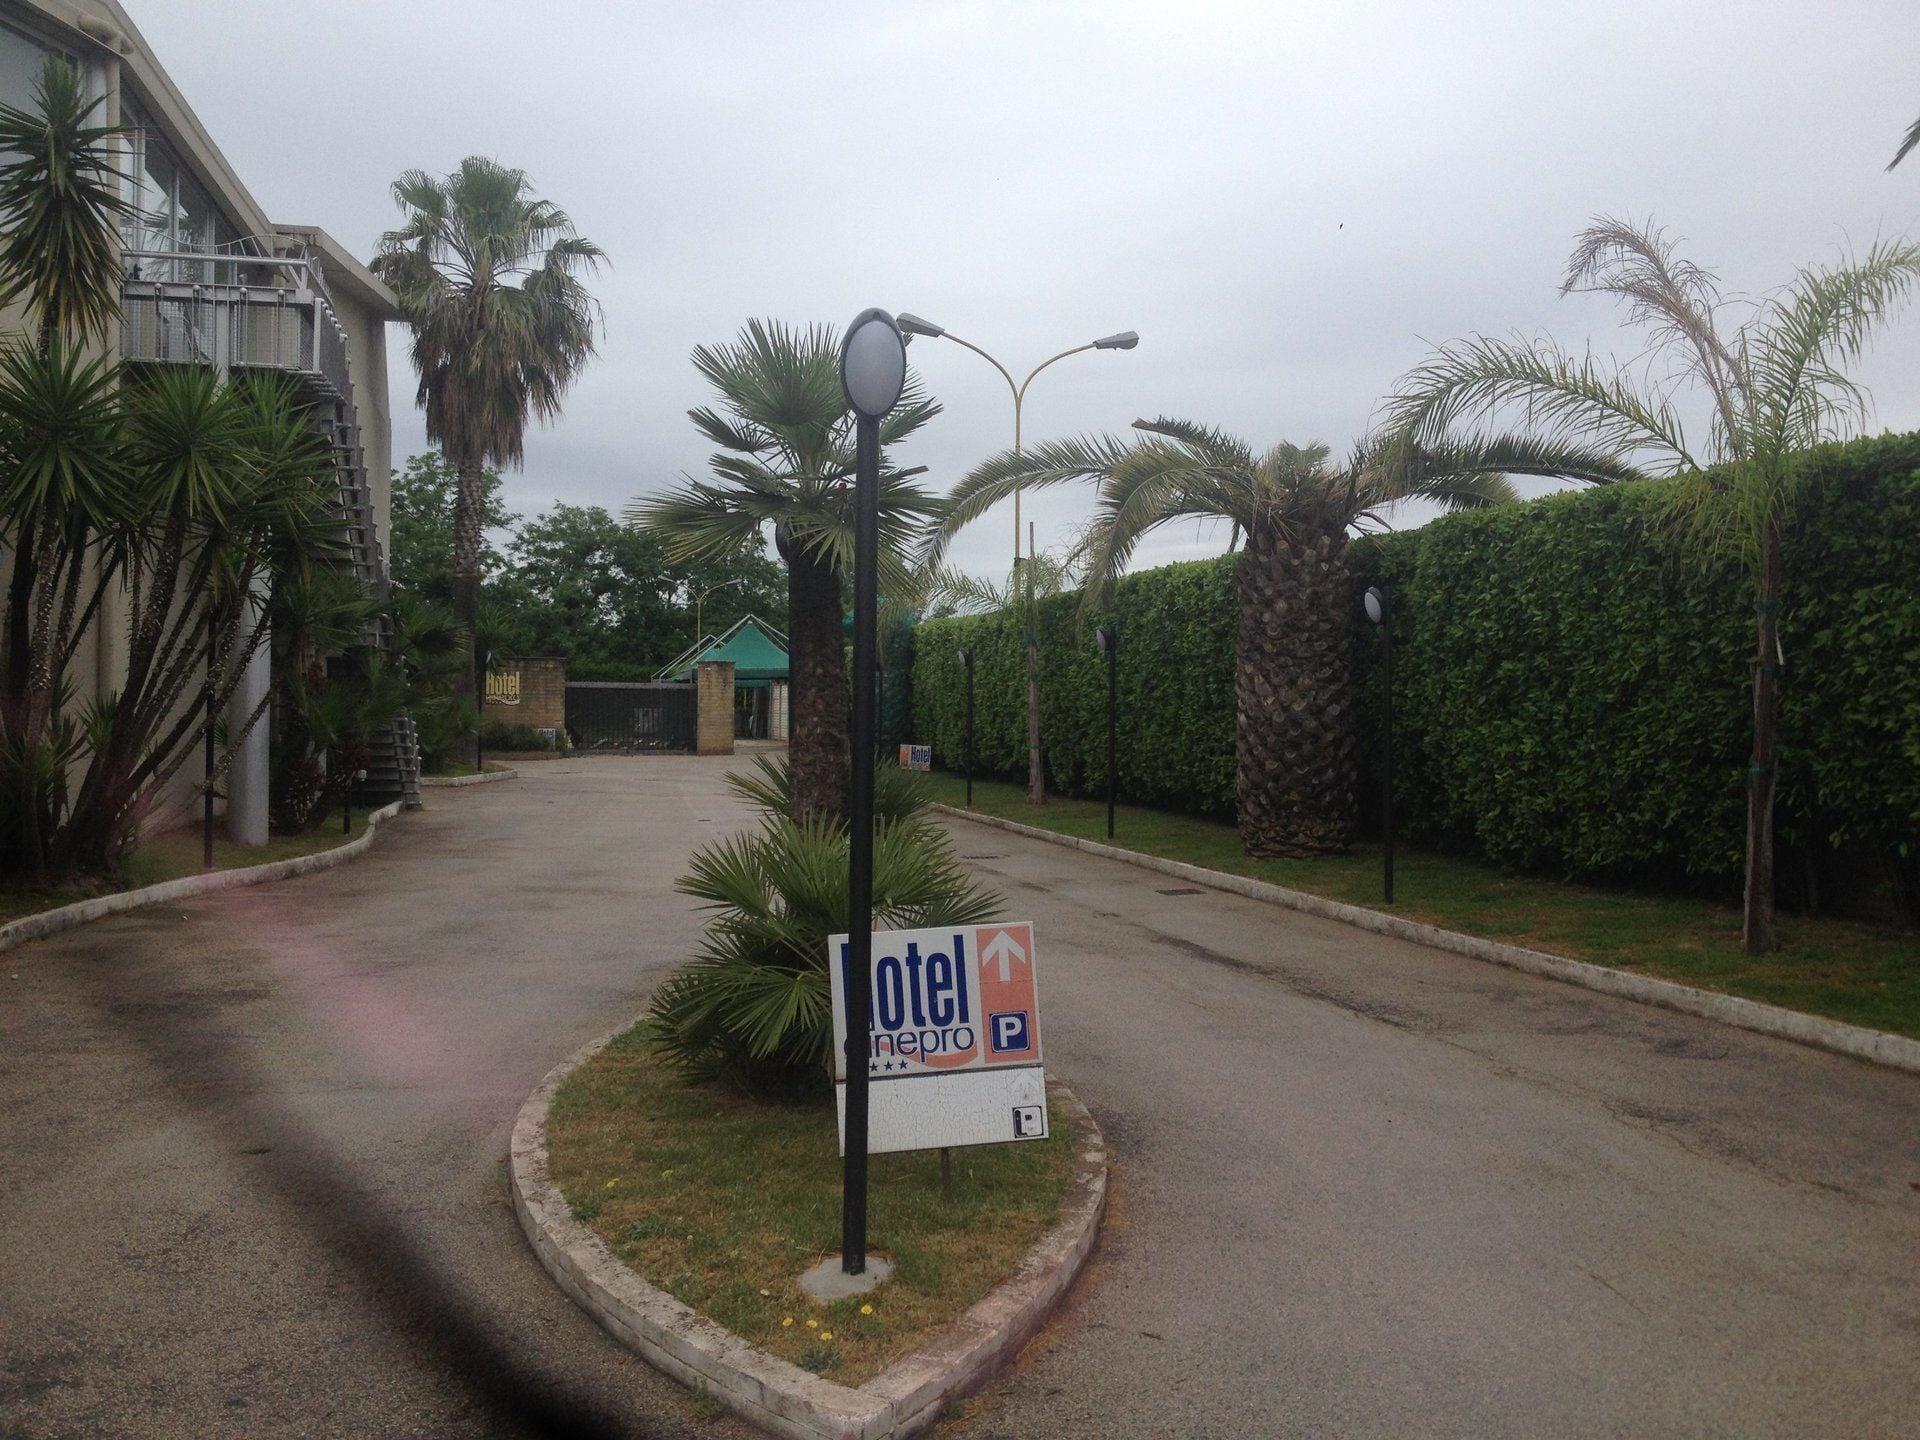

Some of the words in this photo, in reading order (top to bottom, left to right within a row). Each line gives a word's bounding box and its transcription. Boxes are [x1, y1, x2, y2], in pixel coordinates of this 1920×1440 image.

[485, 671, 520, 695] Hotel
[911, 746, 930, 763] Hotel
[843, 1027, 975, 1063] nepro
[998, 1016, 1022, 1048] P
